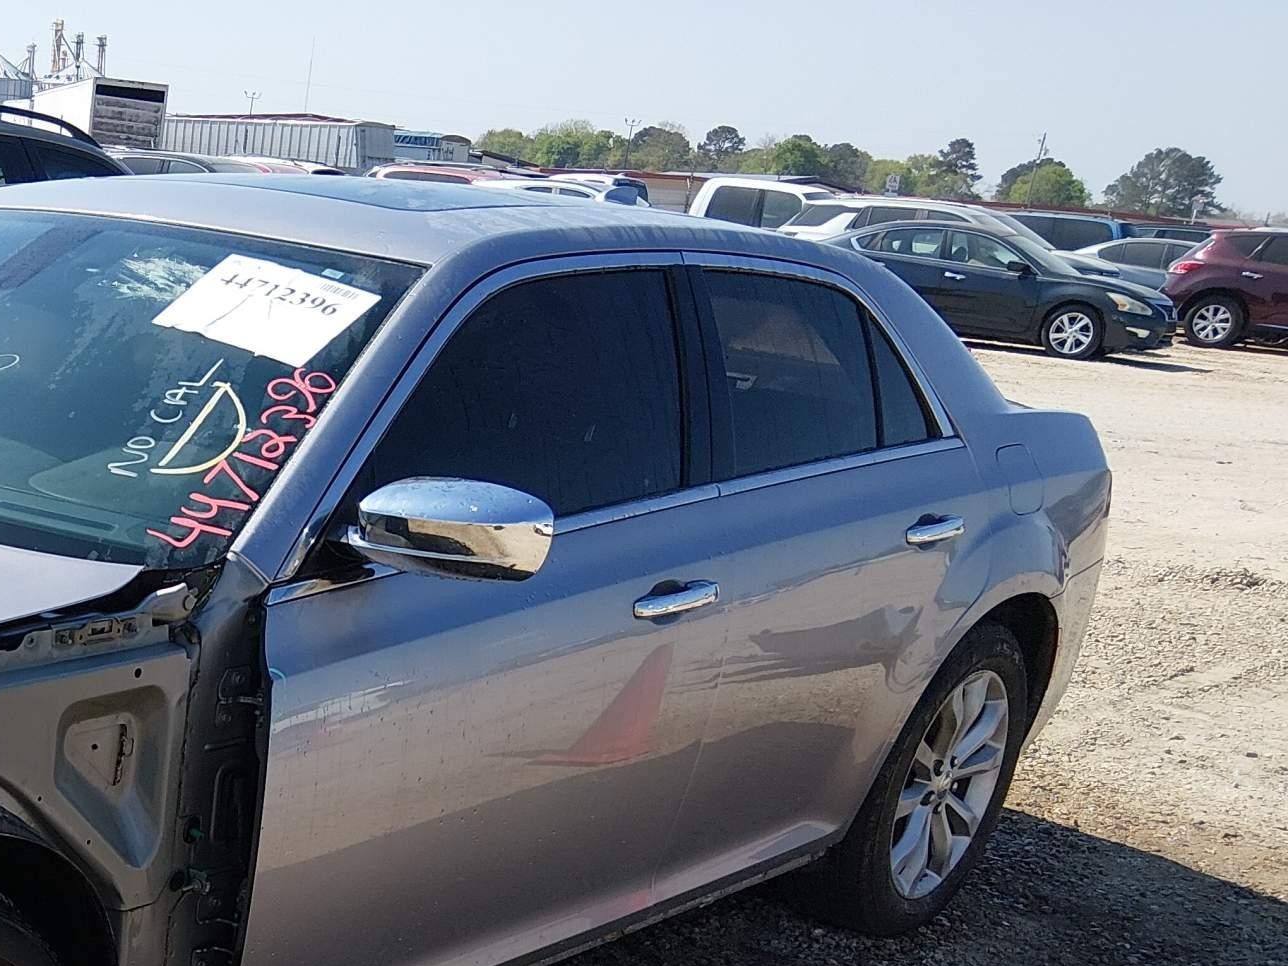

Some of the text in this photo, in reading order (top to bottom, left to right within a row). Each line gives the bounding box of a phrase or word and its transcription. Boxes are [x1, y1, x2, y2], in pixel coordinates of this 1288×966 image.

[220, 273, 343, 316] 44712396
[107, 358, 225, 477] NO CAL
[146, 367, 337, 548] 44712396
